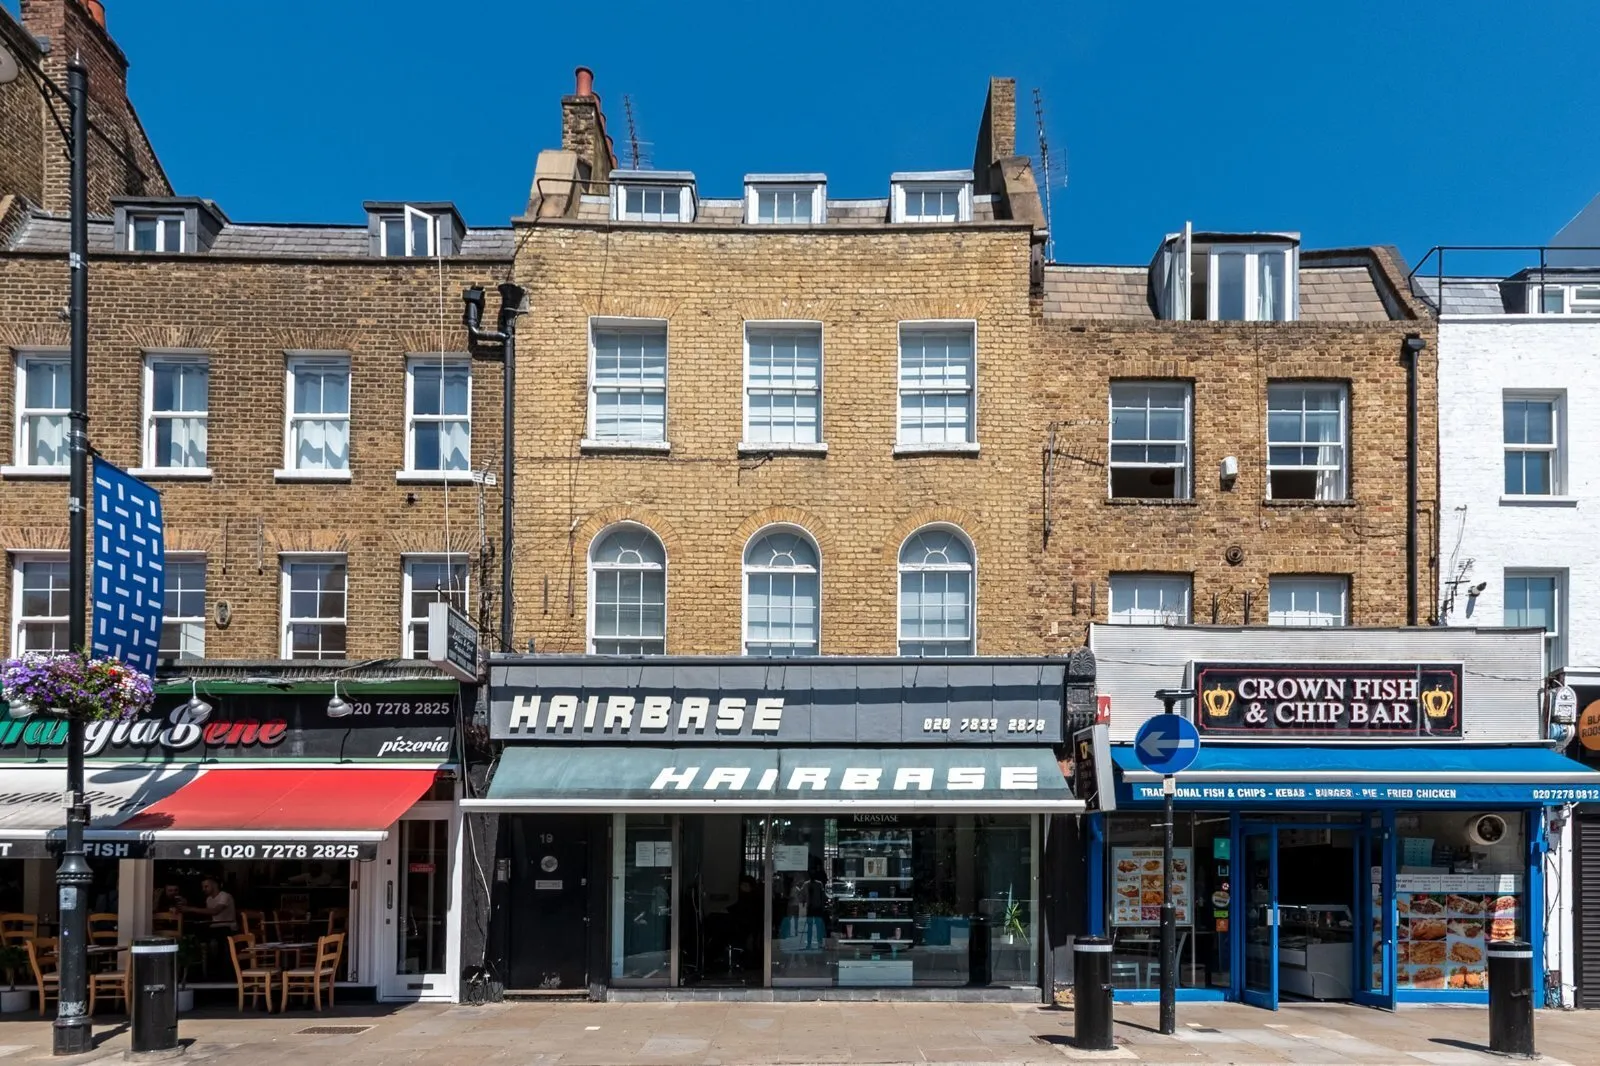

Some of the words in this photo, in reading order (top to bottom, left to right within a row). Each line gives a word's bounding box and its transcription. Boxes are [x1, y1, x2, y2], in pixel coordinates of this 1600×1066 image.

[1238, 678, 1347, 700] CROWN
[1353, 678, 1419, 701] FISH
[375, 703, 410, 715] 7278
[414, 703, 450, 715] 2825
[509, 695, 785, 731] HAIRBASE
[1246, 702, 1268, 723] &
[1275, 702, 1344, 723] CHIP
[1350, 702, 1412, 723] BAR
[923, 718, 951, 731] 020
[960, 718, 998, 731] 7833
[1008, 718, 1046, 731] 2878
[377, 736, 449, 757] pizzeria
[649, 767, 1038, 790] HAIRBASE
[1140, 788, 1201, 797] TRADIONAL
[1203, 788, 1225, 798] FISH
[1227, 788, 1235, 797] &
[1237, 788, 1266, 798] CHIPS
[1275, 788, 1305, 798] KEBAB
[1315, 788, 1352, 798] BURGER
[1362, 789, 1377, 798] PIE
[1387, 789, 1413, 798] FRIED
[1416, 789, 1457, 799] CHICKEN
[540, 833, 554, 844] 19
[82, 843, 129, 857] FISH
[197, 845, 215, 858] T:
[221, 845, 256, 858] 020
[261, 845, 307, 858] 7278
[312, 845, 359, 858] 2825
